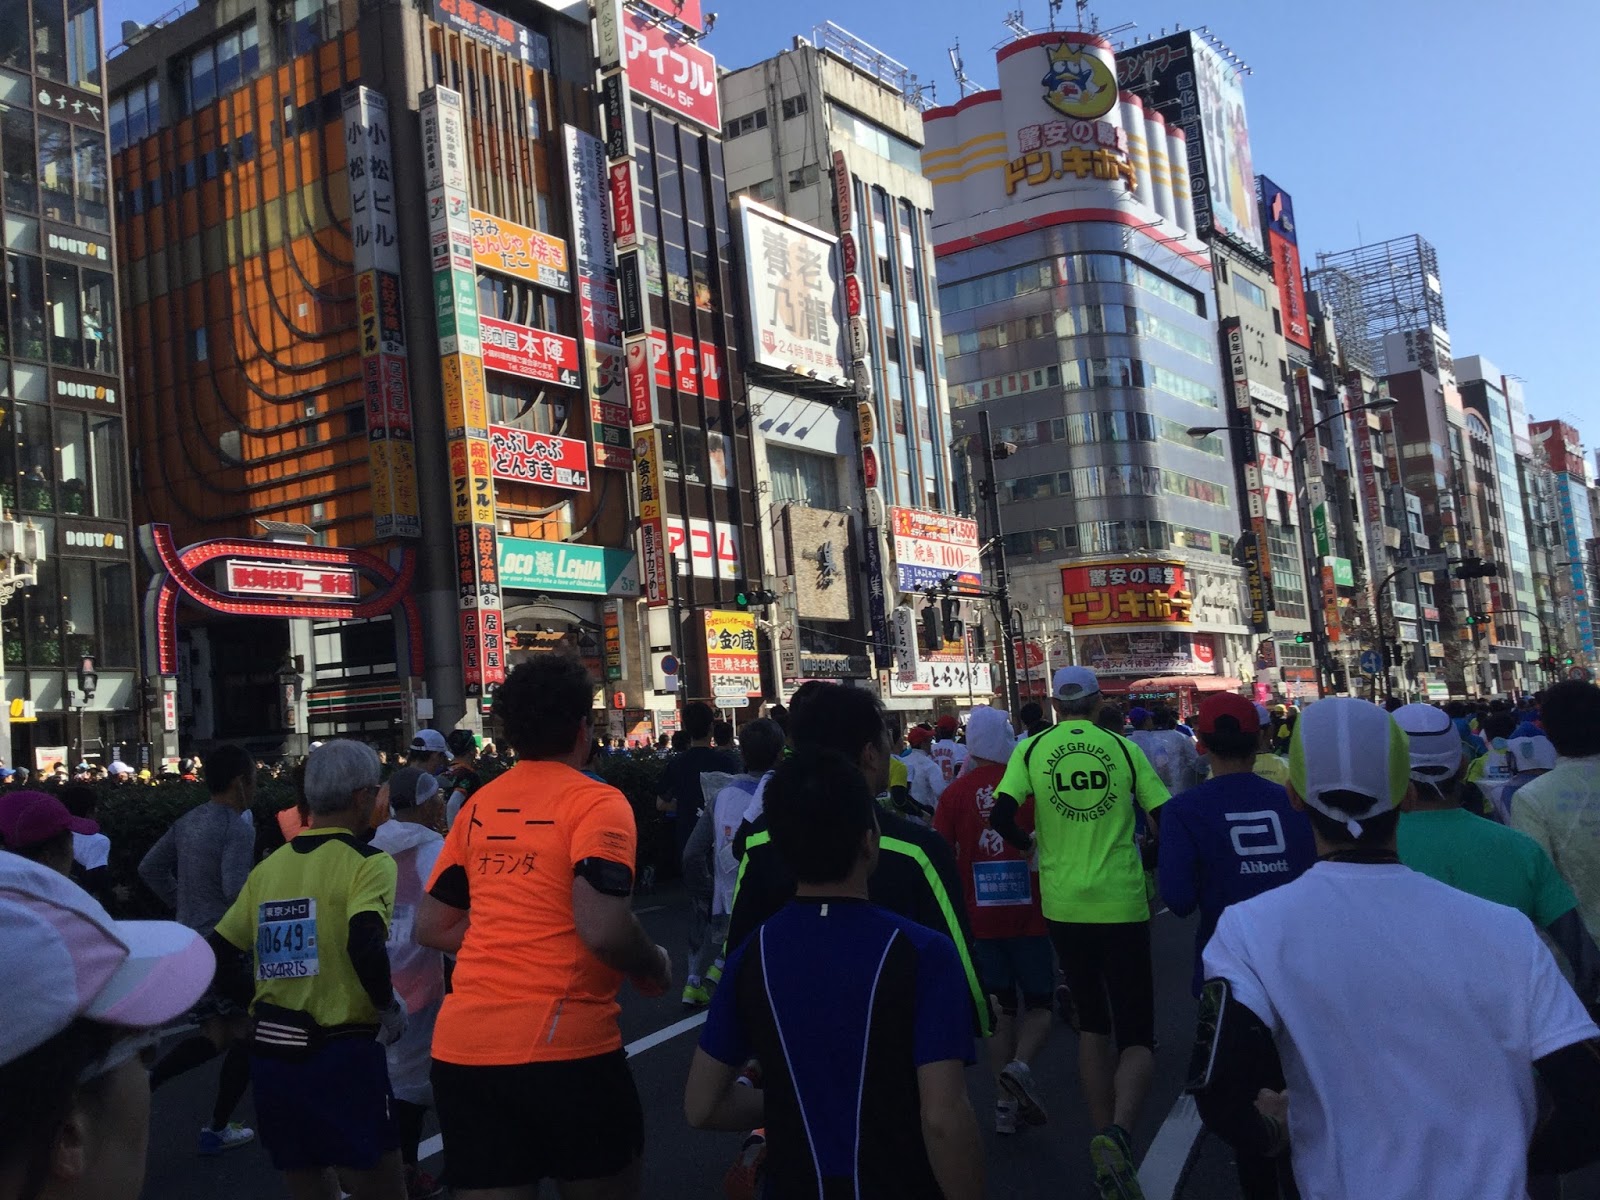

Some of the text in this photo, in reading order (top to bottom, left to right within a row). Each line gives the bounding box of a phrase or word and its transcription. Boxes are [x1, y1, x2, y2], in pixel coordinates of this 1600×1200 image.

[625, 27, 713, 96] アイフル
[678, 90, 694, 107] 5F
[348, 121, 369, 247] 小松ビル
[368, 123, 394, 247] 小松ビル
[595, 141, 612, 265] OKONOMIYAKI HONJIN
[616, 181, 632, 233] アイフル
[471, 219, 499, 236] 好み
[49, 233, 107, 261] DOUTOR
[473, 234, 522, 254] もんじゃ
[529, 235, 563, 266] 焼き
[622, 236, 632, 245] 5F
[501, 251, 530, 267] たこ
[558, 274, 569, 288] 7F
[386, 341, 400, 352] 8F
[610, 334, 621, 346] 4F
[652, 337, 721, 380] アイフル
[1231, 332, 1244, 375] 6年4組
[561, 369, 577, 385] 4F
[682, 377, 694, 389] 5F
[57, 380, 115, 403] DOUTOR
[633, 374, 647, 411] アコム
[593, 404, 627, 425] たばこ
[637, 414, 647, 422] 3F
[604, 427, 619, 444] 酒
[490, 433, 563, 460] ゃぶしゃぶ
[451, 442, 468, 507] 麻雀フル
[470, 442, 490, 507] 麻雀フル
[490, 453, 555, 481] どんすき
[572, 471, 586, 486] 4F
[638, 459, 652, 502] 金の蔵
[458, 509, 467, 521] 6F
[478, 509, 489, 521] 6F
[644, 505, 656, 516] 2F
[66, 531, 124, 550] DOUTOR
[668, 526, 738, 561] アコム
[458, 528, 472, 583] お好み焼
[479, 527, 496, 583] お好み焼
[643, 525, 658, 600] 東京チカラめし
[233, 567, 353, 594] 歌舞伎町一番街
[621, 577, 636, 590] 3F
[1089, 567, 1176, 588] 驚安の殿堂
[480, 584, 497, 594] 本陣
[464, 597, 477, 606] 8F
[484, 596, 495, 606] 8F
[465, 615, 476, 667] 居酒屋
[485, 614, 499, 667] 居酒屋
[719, 628, 755, 650] 金の蔵
[724, 658, 758, 672] 焼き牛丼
[469, 684, 479, 692] 4F
[1043, 742, 1117, 775] LAUFGRUPPE
[1055, 771, 1108, 792] LGD
[1050, 792, 1118, 822] DEIRINGSEN
[467, 803, 555, 847] トニー
[477, 853, 537, 876] オランダ
[1240, 859, 1289, 875] Abbott
[266, 904, 307, 917] 東京メトロ
